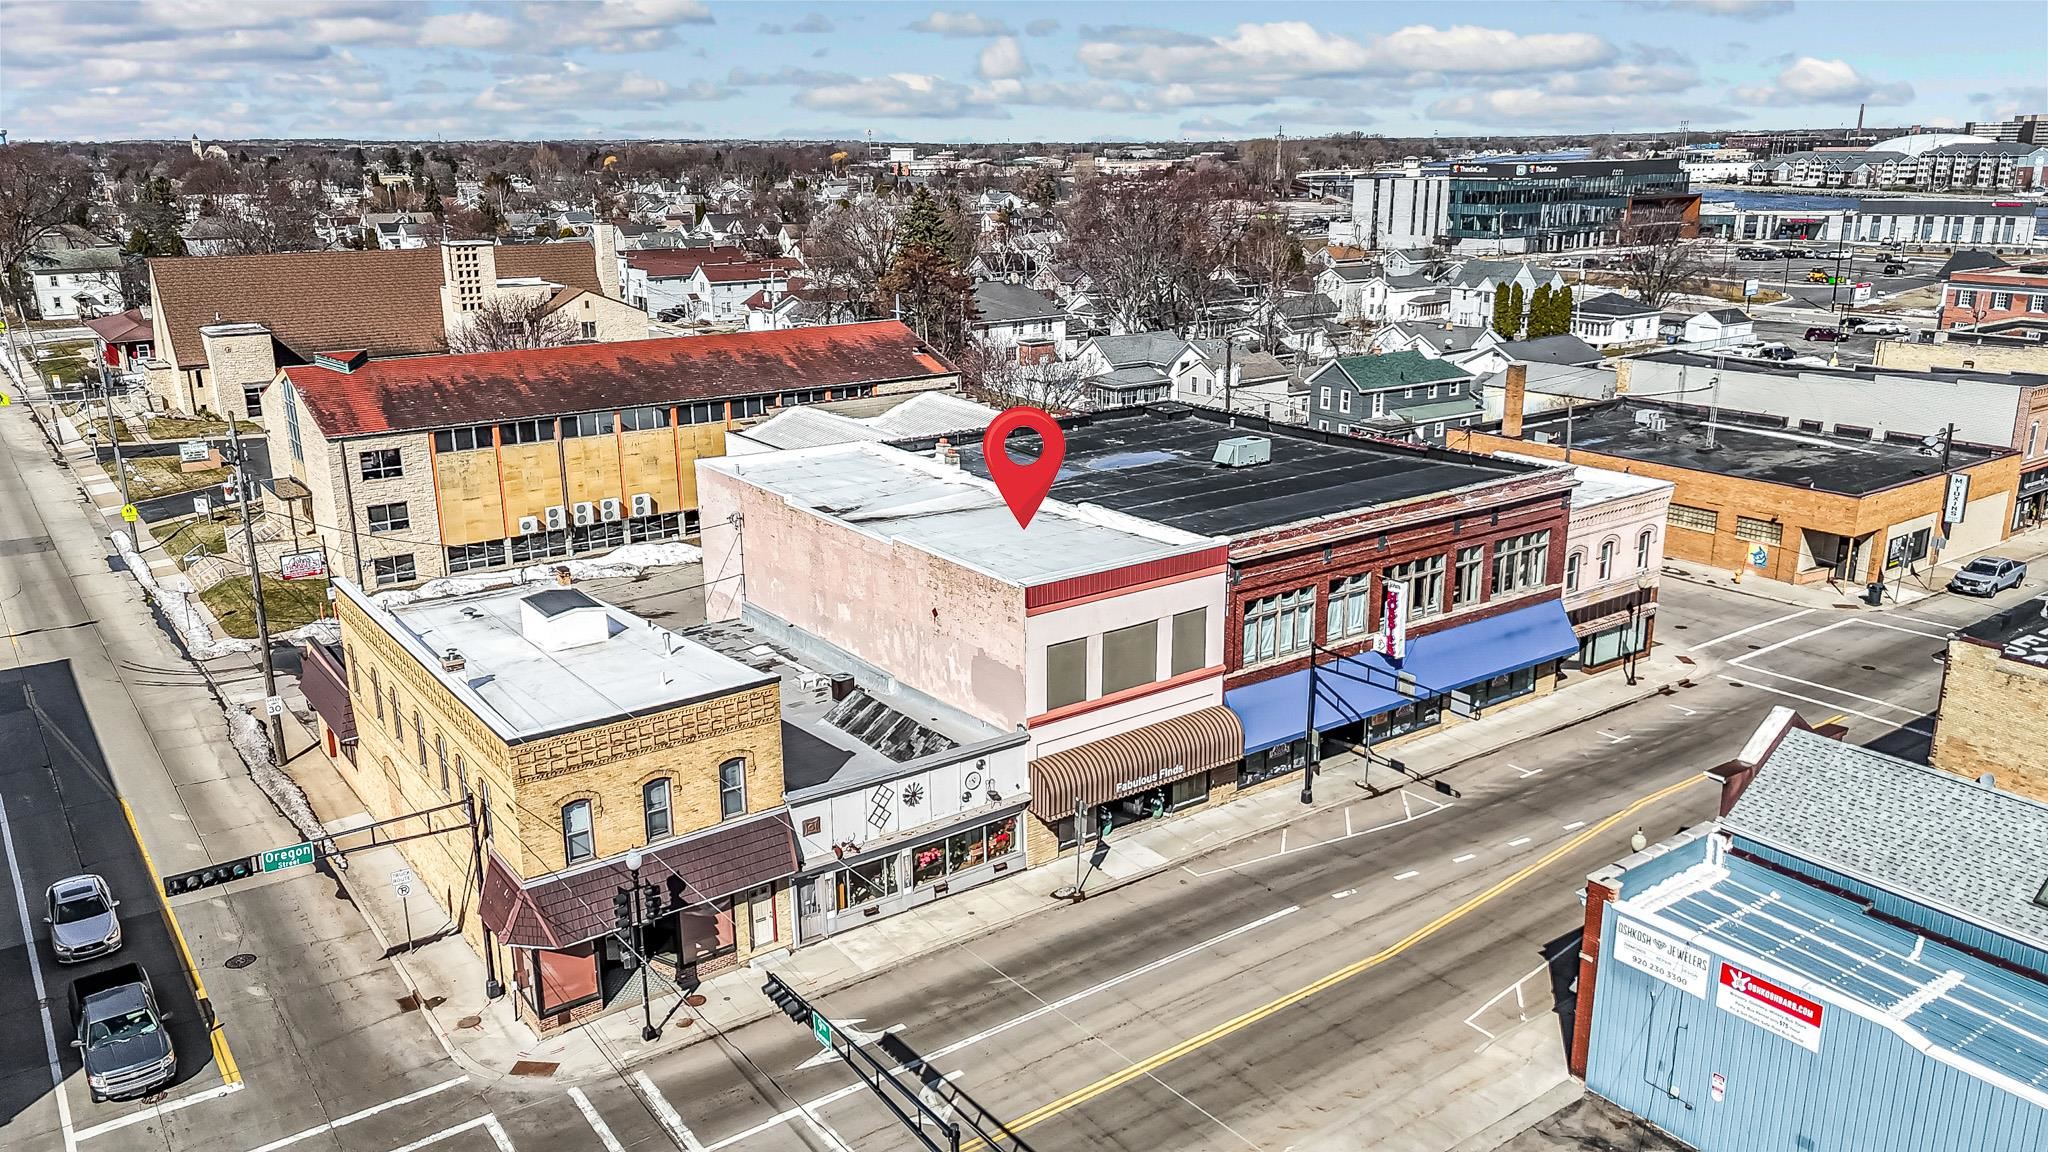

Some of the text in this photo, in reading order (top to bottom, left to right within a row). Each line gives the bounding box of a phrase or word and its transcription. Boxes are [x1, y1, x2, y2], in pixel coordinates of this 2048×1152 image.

[269, 705, 281, 713] 30
[1116, 764, 1184, 792] Fabulous Finds
[265, 845, 311, 863] Oregon
[278, 858, 300, 869] Street
[1618, 922, 1652, 945] OSHKOSH
[1667, 944, 1708, 971] JEWELERS
[1632, 955, 1648, 967] 920
[1649, 963, 1665, 975] 230
